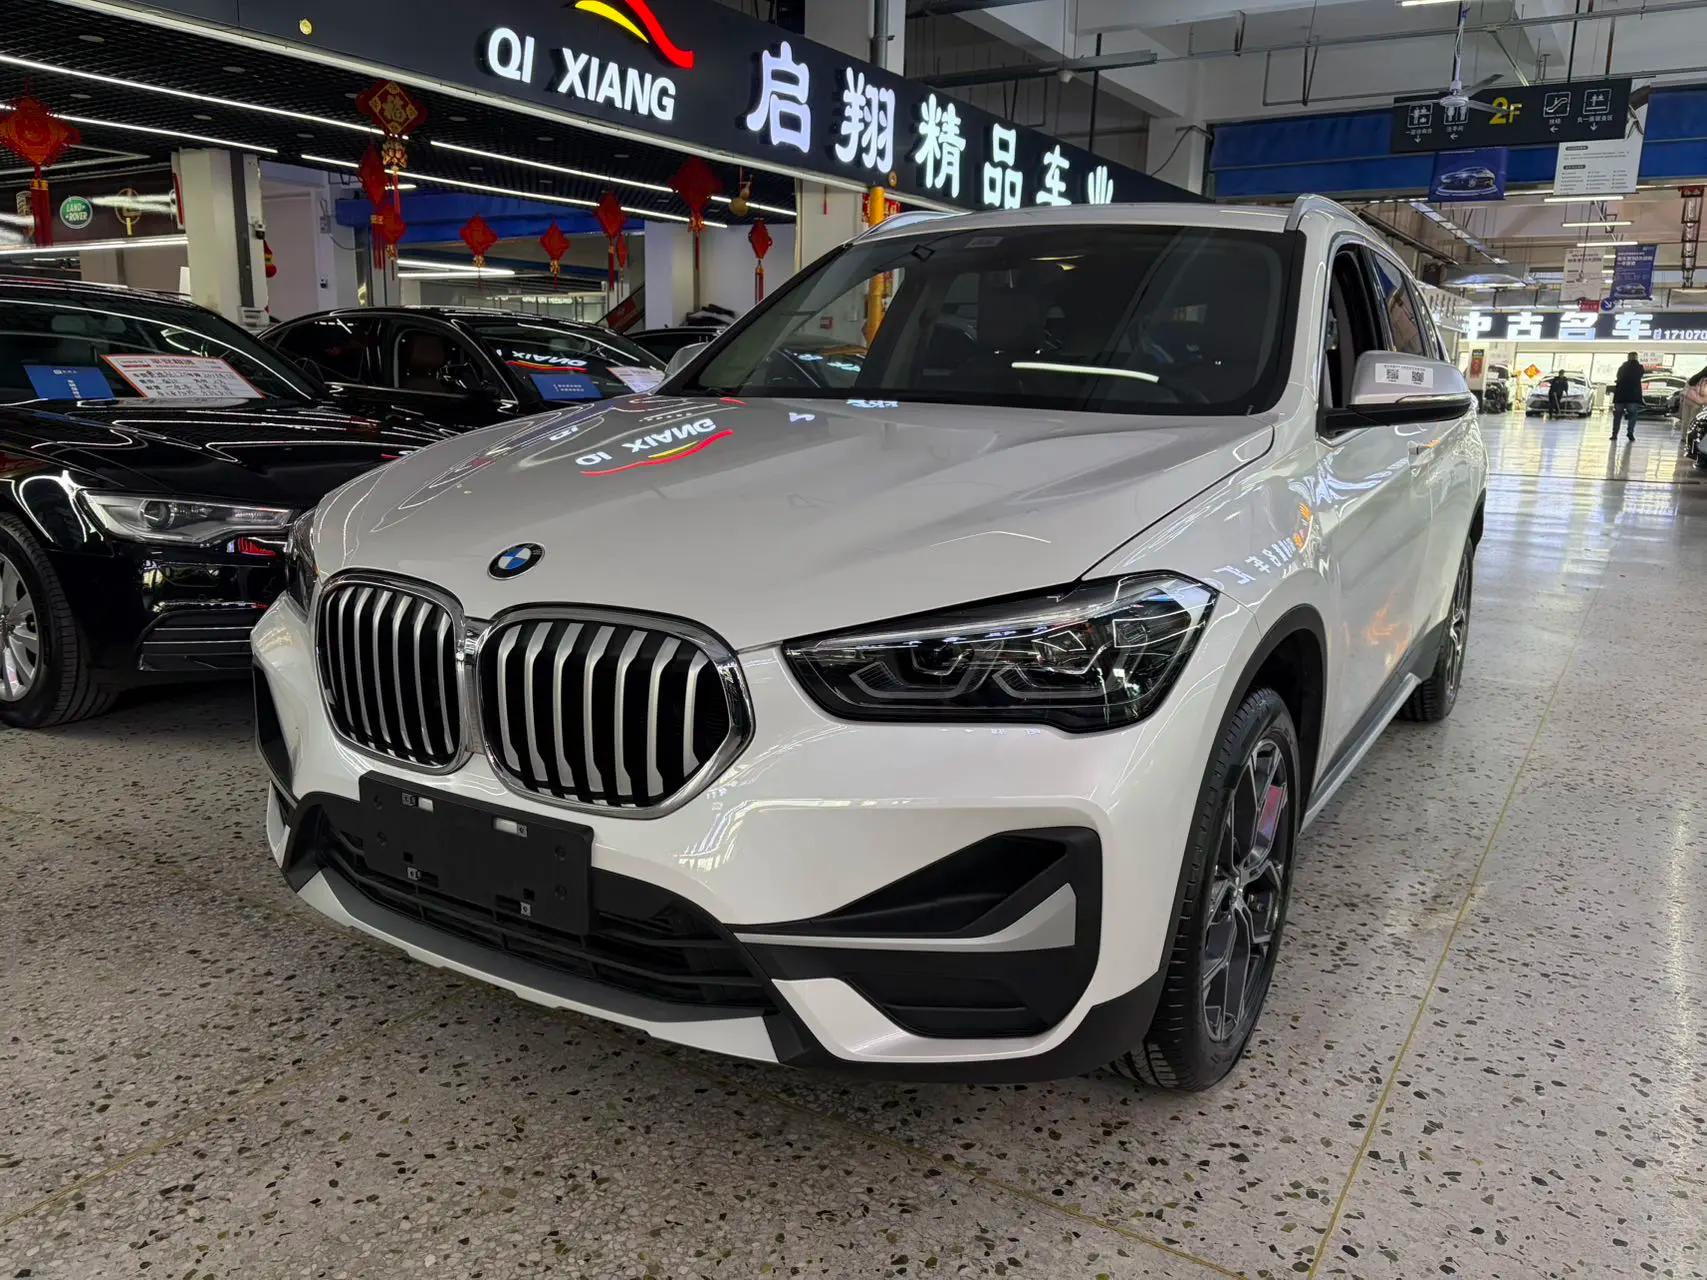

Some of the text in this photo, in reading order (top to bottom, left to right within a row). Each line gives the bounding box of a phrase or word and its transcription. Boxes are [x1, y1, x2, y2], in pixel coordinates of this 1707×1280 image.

[488, 27, 677, 121] QI XIANG
[746, 40, 1114, 209] 启翔精品车业
[1489, 96, 1523, 125] 2F
[66, 202, 82, 212] LAND
[68, 211, 88, 222] ROVER
